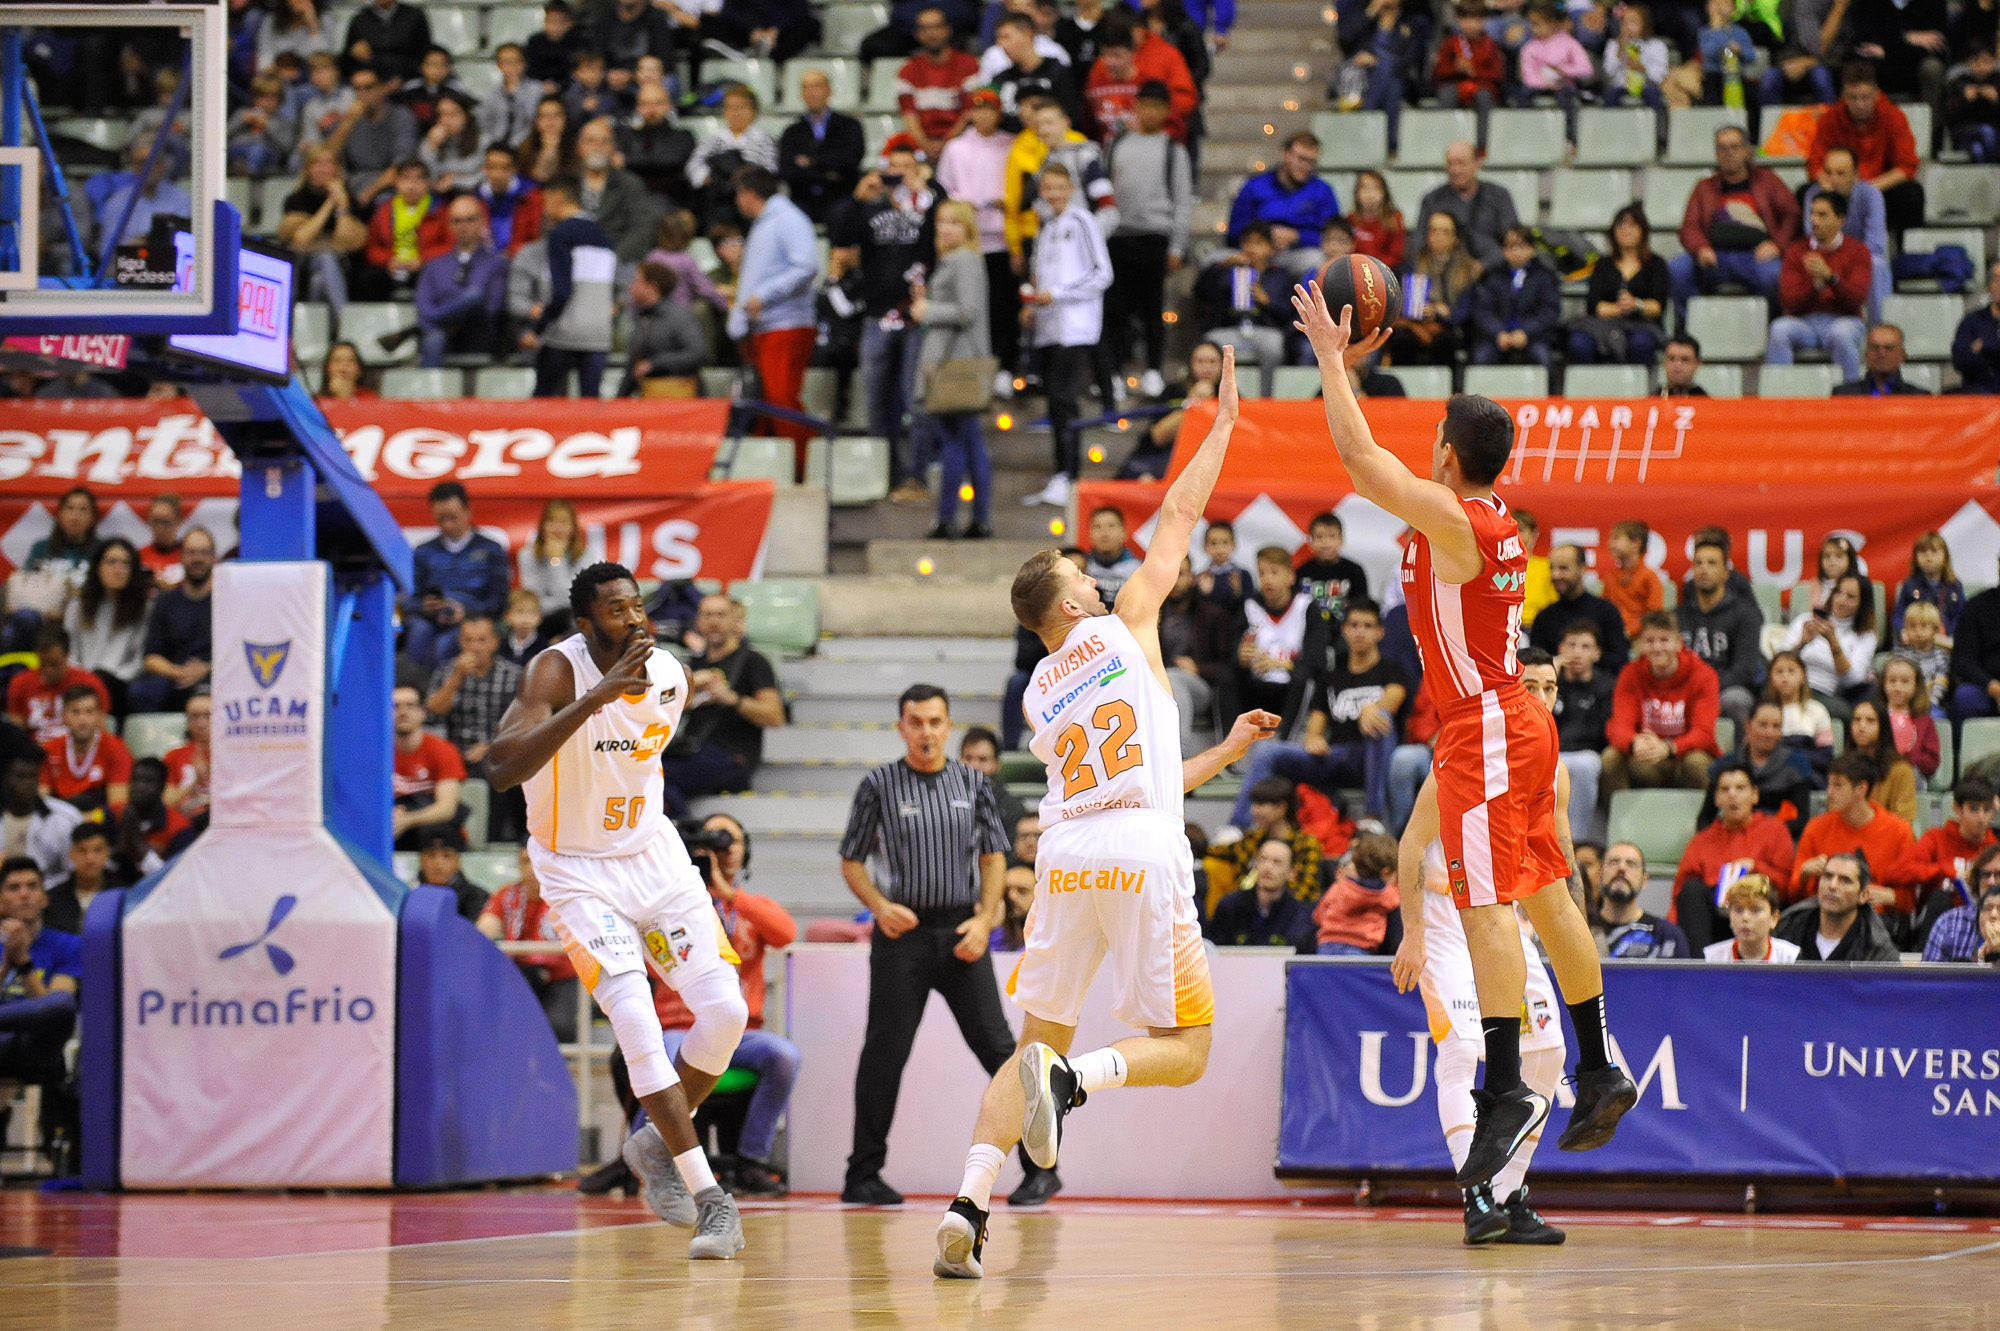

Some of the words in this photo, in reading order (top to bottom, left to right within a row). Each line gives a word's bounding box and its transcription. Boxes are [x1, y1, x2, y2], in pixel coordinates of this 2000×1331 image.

[1037, 634, 1106, 695] STAUSKAS
[1042, 656, 1123, 724] Loramendi
[225, 697, 308, 722] UCAM
[1054, 698, 1144, 802] 22
[603, 796, 647, 830] 50
[1049, 866, 1146, 895] Recalvi
[1357, 1030, 1688, 1111] UM
